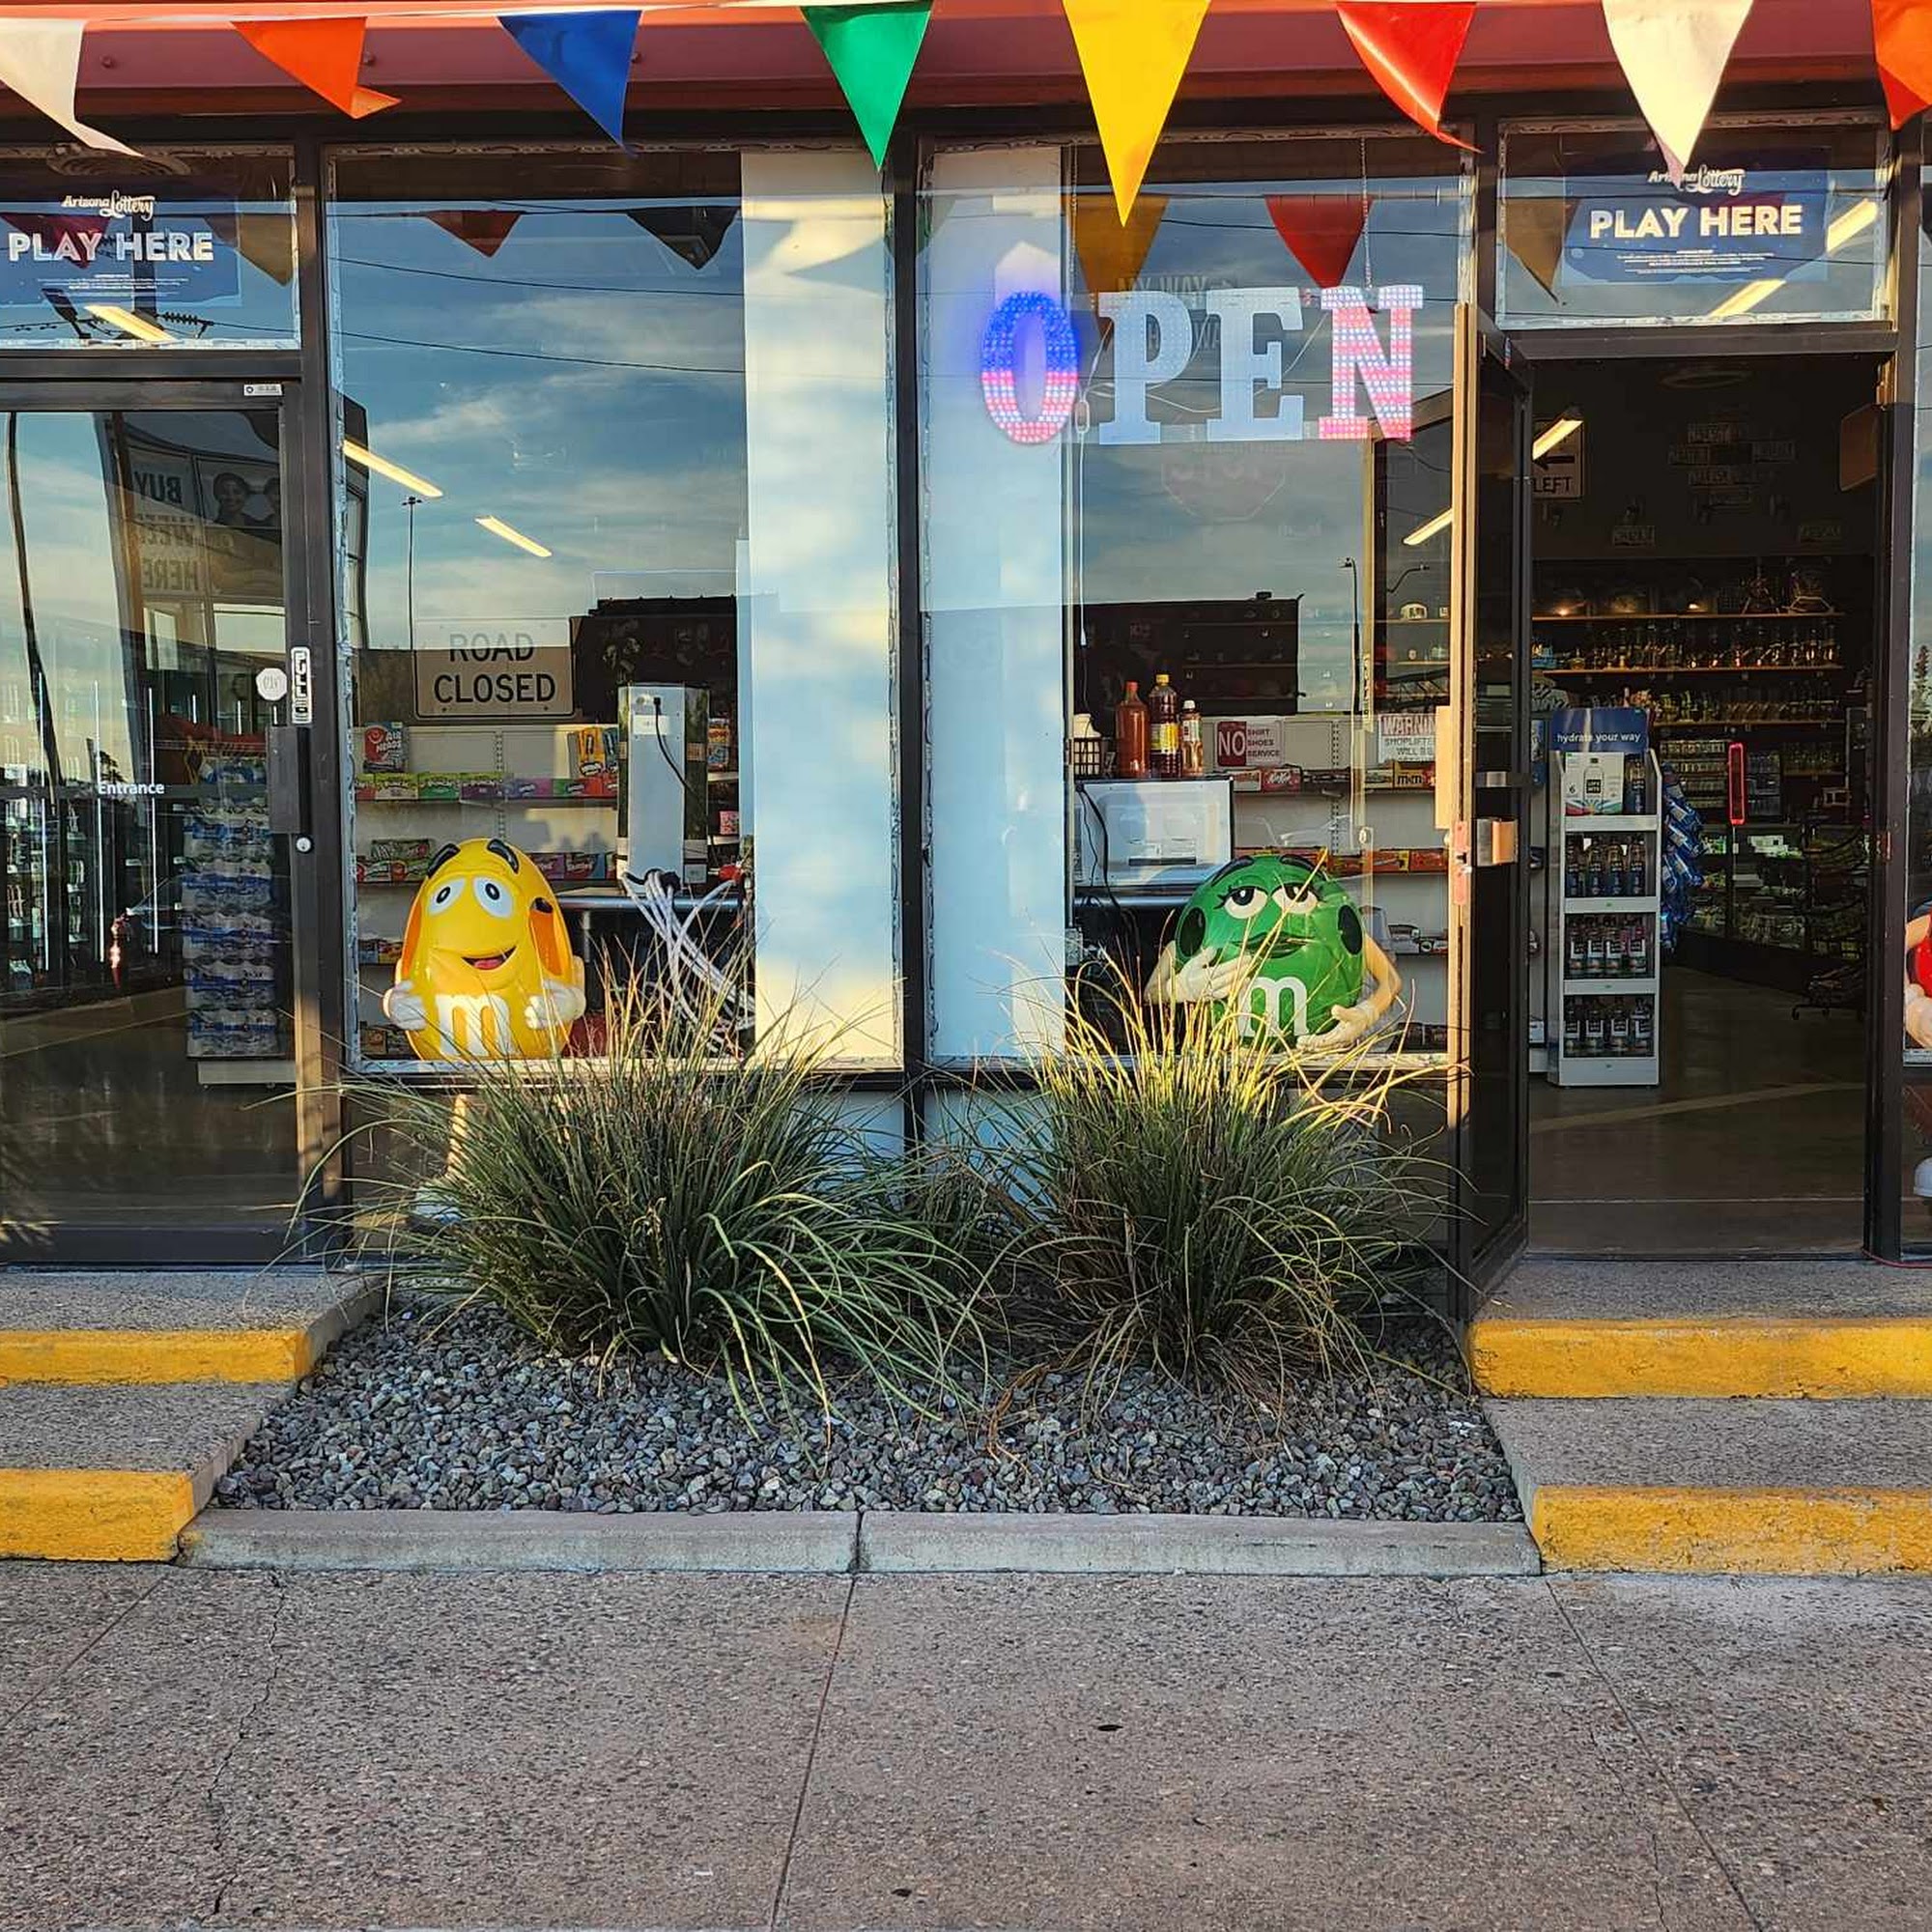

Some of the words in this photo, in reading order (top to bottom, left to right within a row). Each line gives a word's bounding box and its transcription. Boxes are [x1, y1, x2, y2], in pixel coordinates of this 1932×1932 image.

[1685, 163, 1745, 196] Lottery
[61, 195, 110, 208] Arizona
[99, 189, 155, 221] Lottery
[1589, 207, 1690, 240] PLAY
[1699, 204, 1802, 237] HERE
[8, 232, 100, 262] PLAY
[116, 232, 214, 262] HERE
[980, 284, 1425, 446] OPEN
[448, 634, 534, 662] ROAD
[433, 672, 555, 703] CLOSED
[1218, 731, 1246, 756] NO
[1596, 734, 1619, 744] your
[1621, 732, 1641, 743] way
[98, 783, 165, 795] Entrance
[1237, 976, 1309, 1039] m
[434, 993, 514, 1058] m
